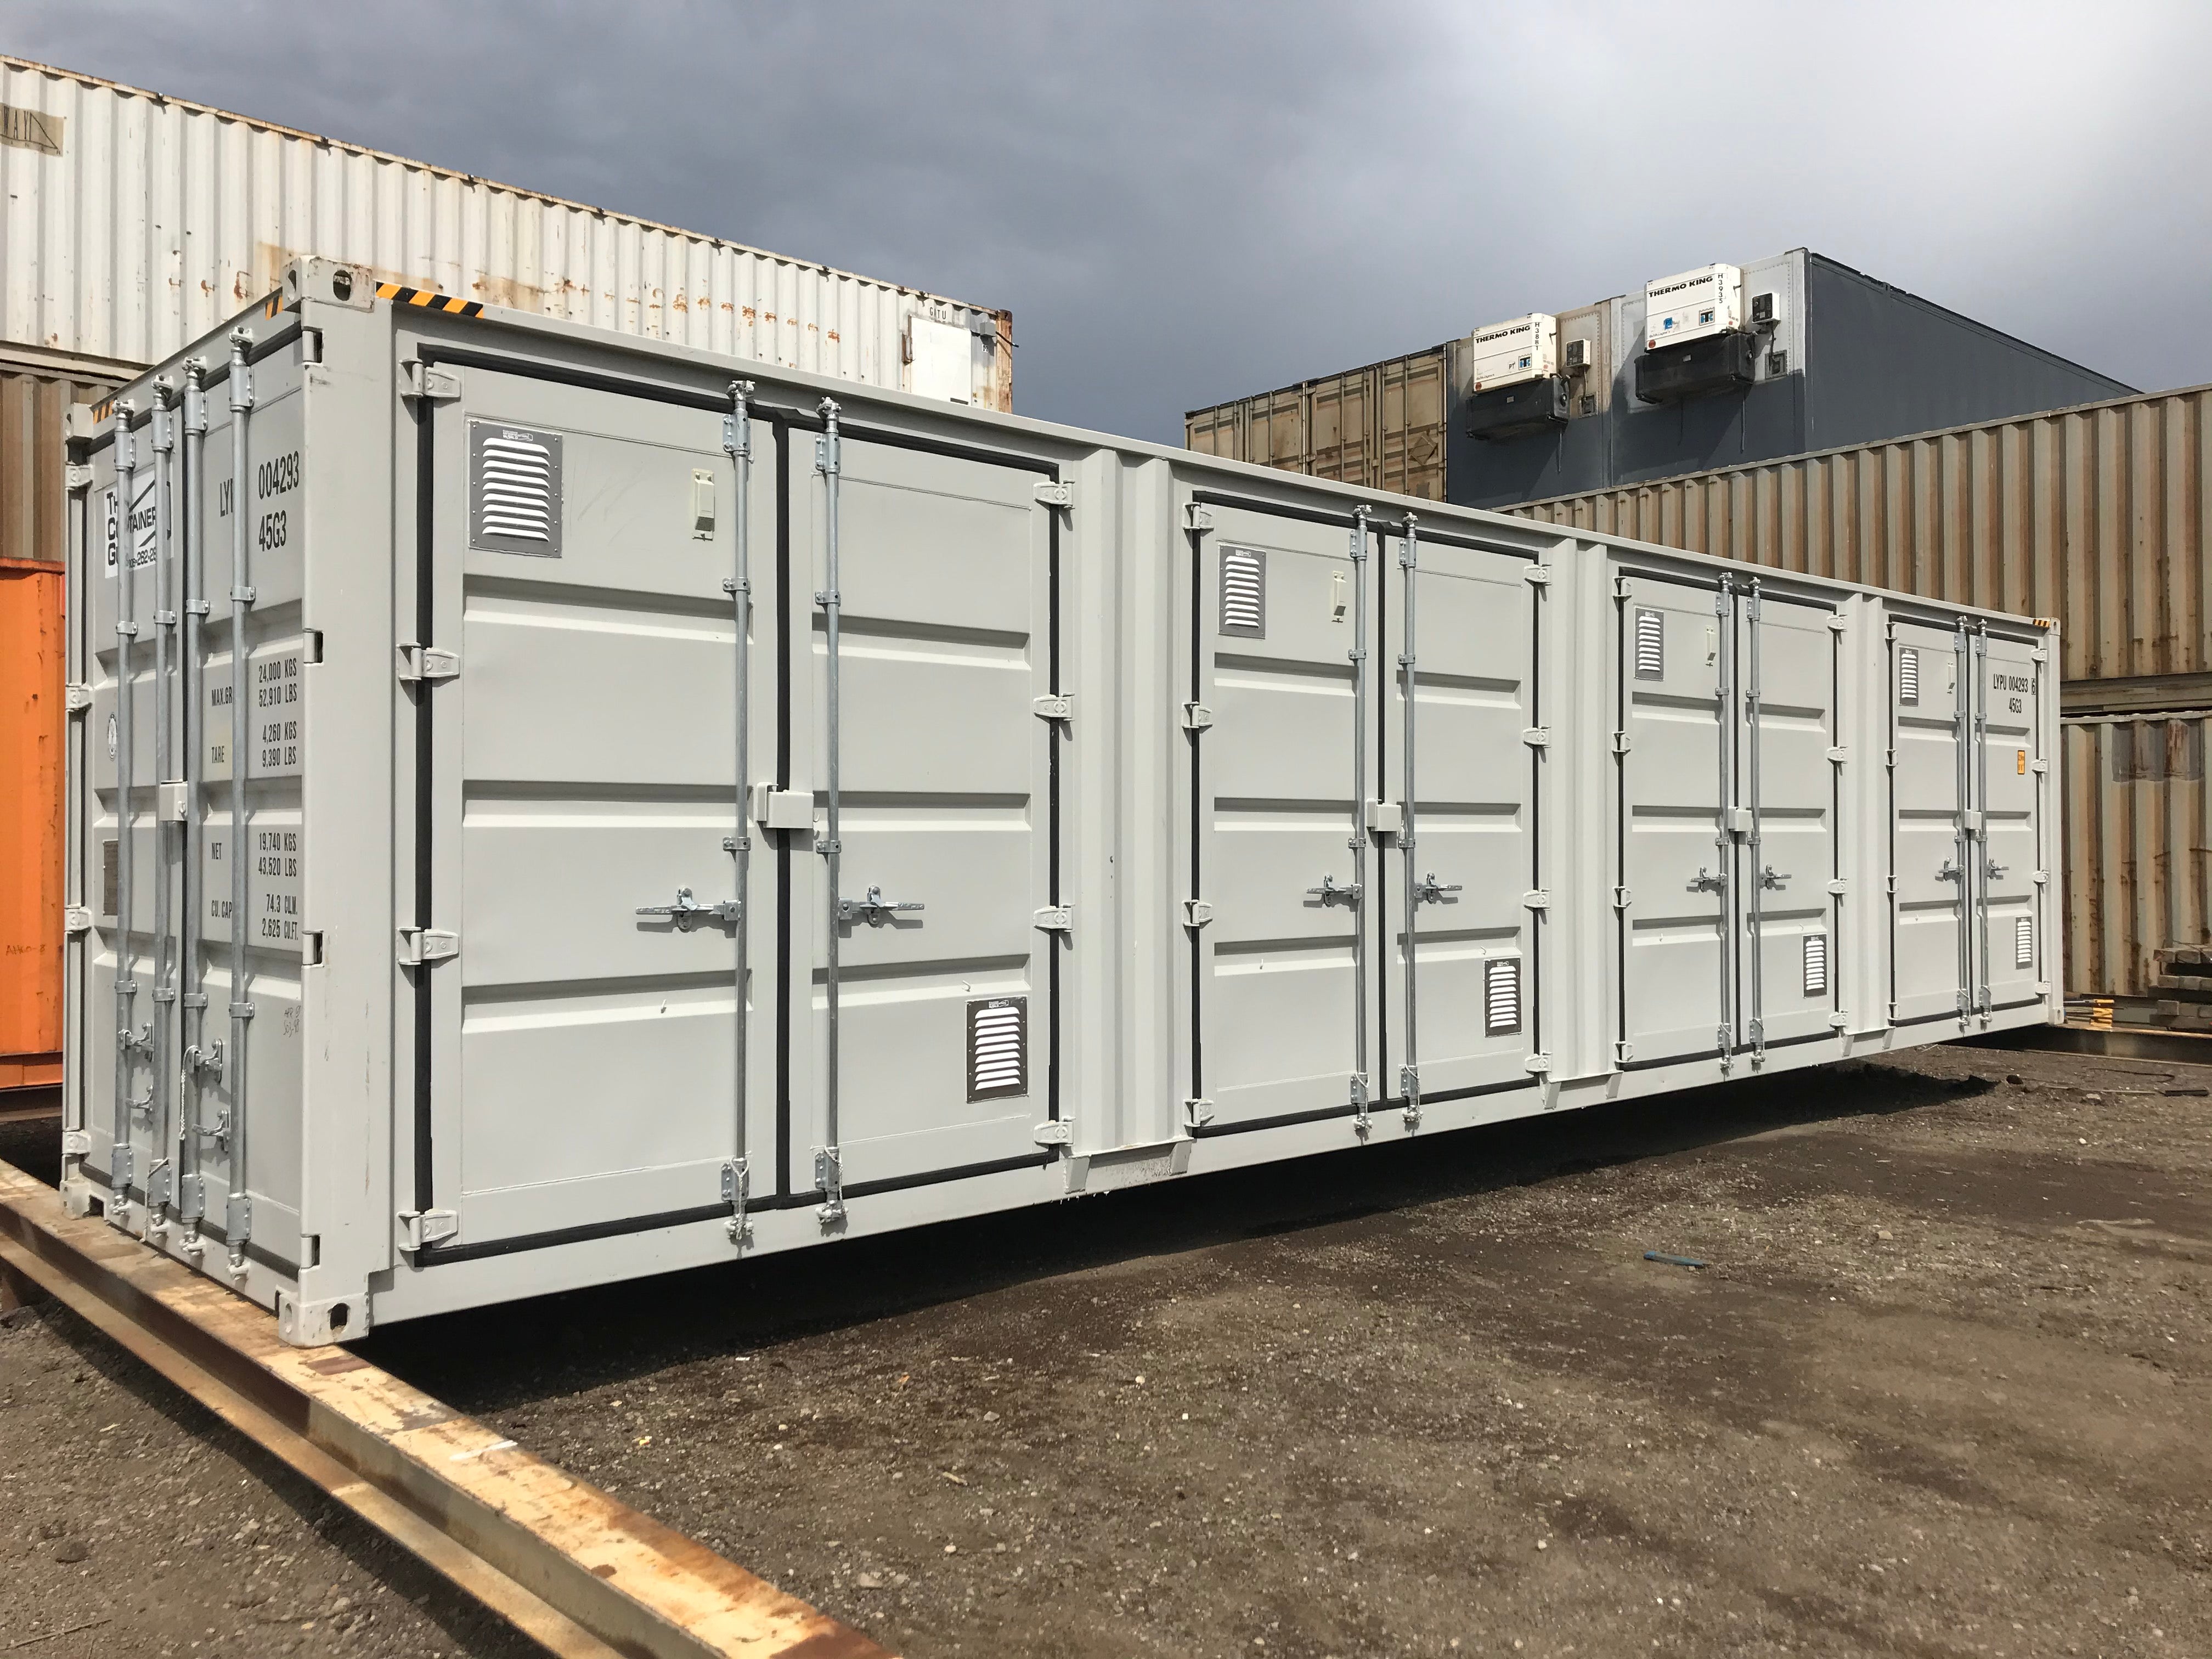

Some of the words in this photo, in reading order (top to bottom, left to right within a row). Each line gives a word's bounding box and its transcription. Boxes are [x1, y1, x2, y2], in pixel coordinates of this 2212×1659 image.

[1649, 284, 1687, 298] THERMO
[1689, 276, 1713, 287] KING
[1476, 331, 1508, 344] THERMO
[1510, 325, 1531, 335] KING
[258, 450, 299, 500] 004293
[258, 510, 286, 551] 45G3
[259, 661, 281, 683] 24,000
[284, 658, 297, 678] KGS
[1994, 673, 2007, 690] LYPU
[2009, 675, 2028, 693] 004293
[259, 686, 281, 707] 52,910
[285, 683, 297, 703] LBS
[2009, 697, 2022, 714] 45G3
[262, 723, 281, 744] 4,260
[284, 721, 297, 741] KGS
[211, 746, 224, 763] TARE
[262, 748, 280, 769] 9,390
[284, 746, 296, 765] LBS
[211, 842, 222, 860] NET
[259, 832, 280, 852] 19,740
[284, 833, 296, 851] KGS
[258, 857, 280, 877] 43,520
[285, 857, 297, 877] LBS
[266, 894, 280, 913] 74.3
[262, 918, 280, 939] 2,625
